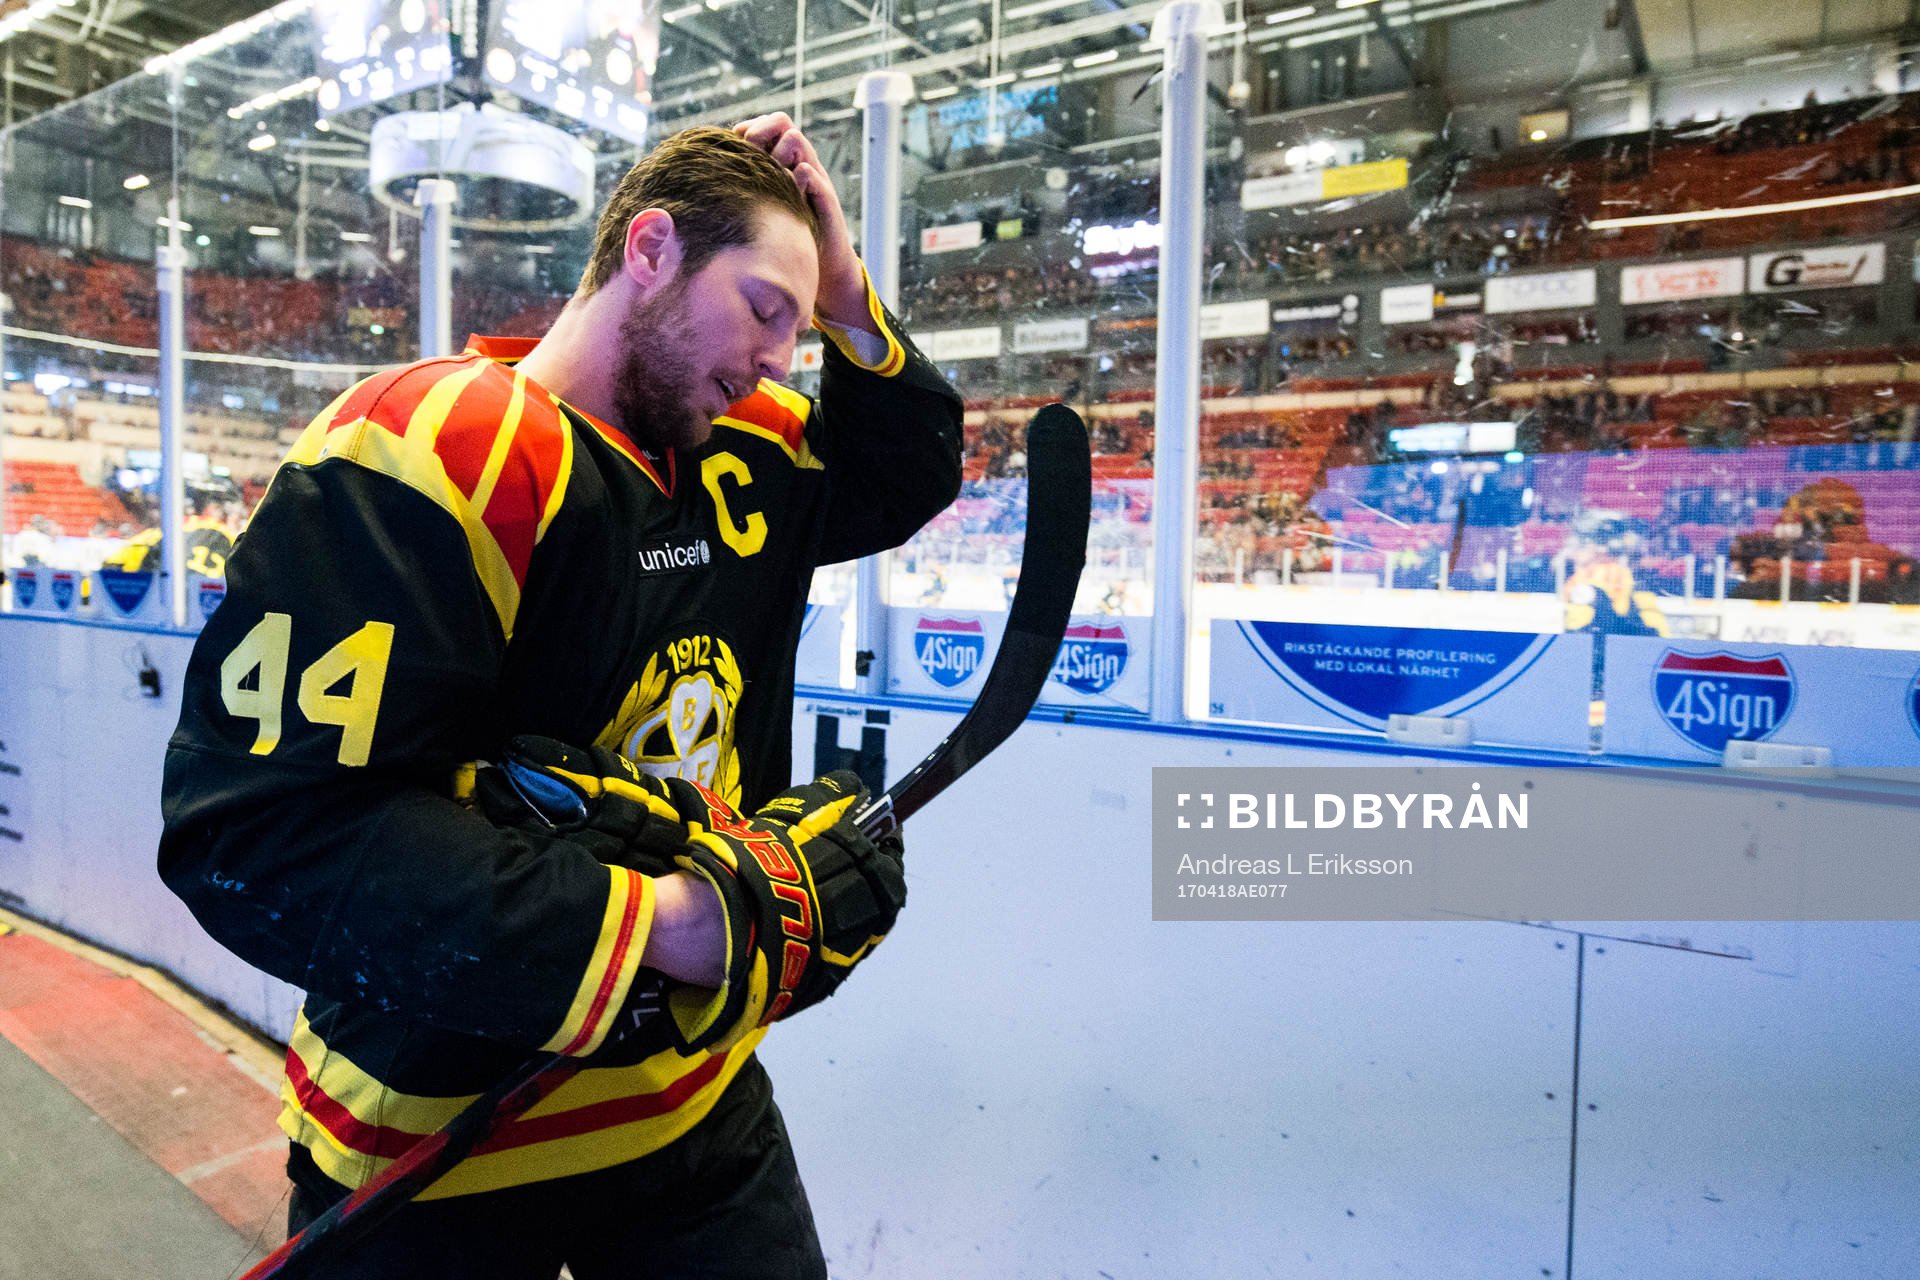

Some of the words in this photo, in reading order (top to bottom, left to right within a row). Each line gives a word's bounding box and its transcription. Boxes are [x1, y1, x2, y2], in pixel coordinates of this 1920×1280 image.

[700, 450, 769, 558] C
[638, 539, 701, 571] unicef
[667, 634, 712, 675] 1912
[920, 635, 979, 679] 4Sign
[1053, 642, 1120, 688] 4Sign
[1284, 641, 1392, 659] RIKSTÄCKANDE
[1395, 647, 1497, 665] PROFILERING
[1314, 660, 1344, 673] MED
[1347, 660, 1394, 676] LOKAL
[1398, 662, 1460, 679] NÄRHET
[220, 611, 395, 768] 44
[1666, 679, 1777, 738] 4Sign
